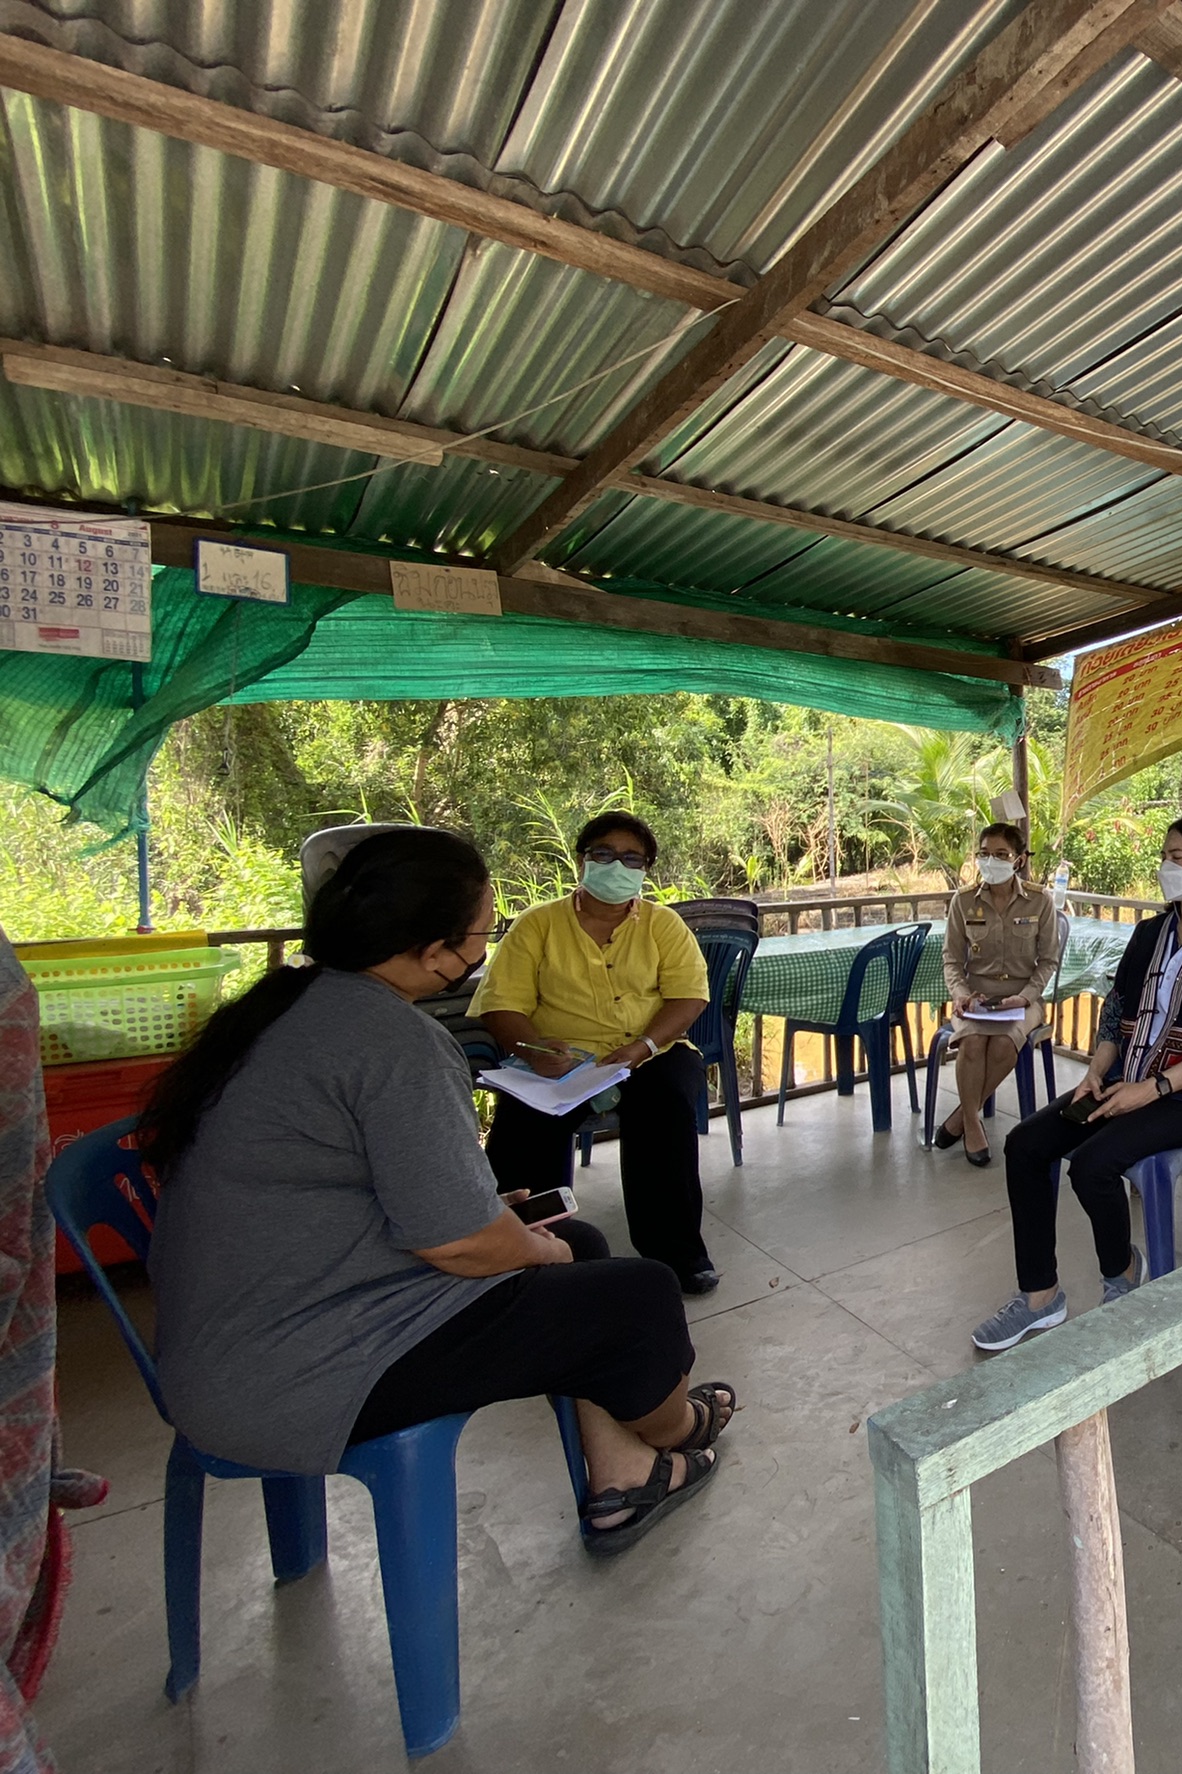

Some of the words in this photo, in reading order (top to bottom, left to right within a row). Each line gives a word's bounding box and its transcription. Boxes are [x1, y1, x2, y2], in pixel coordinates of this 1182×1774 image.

[51, 519, 59, 530] 8
[78, 524, 113, 536] August
[23, 534, 32, 548] 3
[51, 538, 60, 551] 4
[78, 541, 88, 555] 5
[105, 545, 115, 558] 6
[132, 548, 141, 560] 7
[20, 552, 37, 566] 10
[48, 555, 63, 569] 11
[76, 559, 92, 573] 12
[102, 562, 119, 575] 13
[129, 565, 145, 578] 14
[0, 567, 10, 582] 6
[20, 570, 37, 584] 17
[48, 573, 66, 587] 18
[76, 576, 93, 590] 19
[103, 579, 120, 592] 20
[129, 582, 144, 598] 21
[0, 586, 10, 600] 3
[21, 588, 38, 602] 24
[49, 591, 66, 605] 25
[76, 594, 93, 607] 26
[103, 596, 120, 610] 27
[129, 599, 147, 613] 28
[21, 606, 38, 621] 31
[1139, 665, 1158, 677] บาท
[1117, 687, 1130, 699] 20
[1134, 678, 1152, 691] บาท
[1128, 692, 1146, 705] บาท
[1164, 677, 1180, 689] 25
[1144, 721, 1160, 734] 30
[1163, 711, 1182, 726] บาท
[1150, 706, 1166, 719] 30
